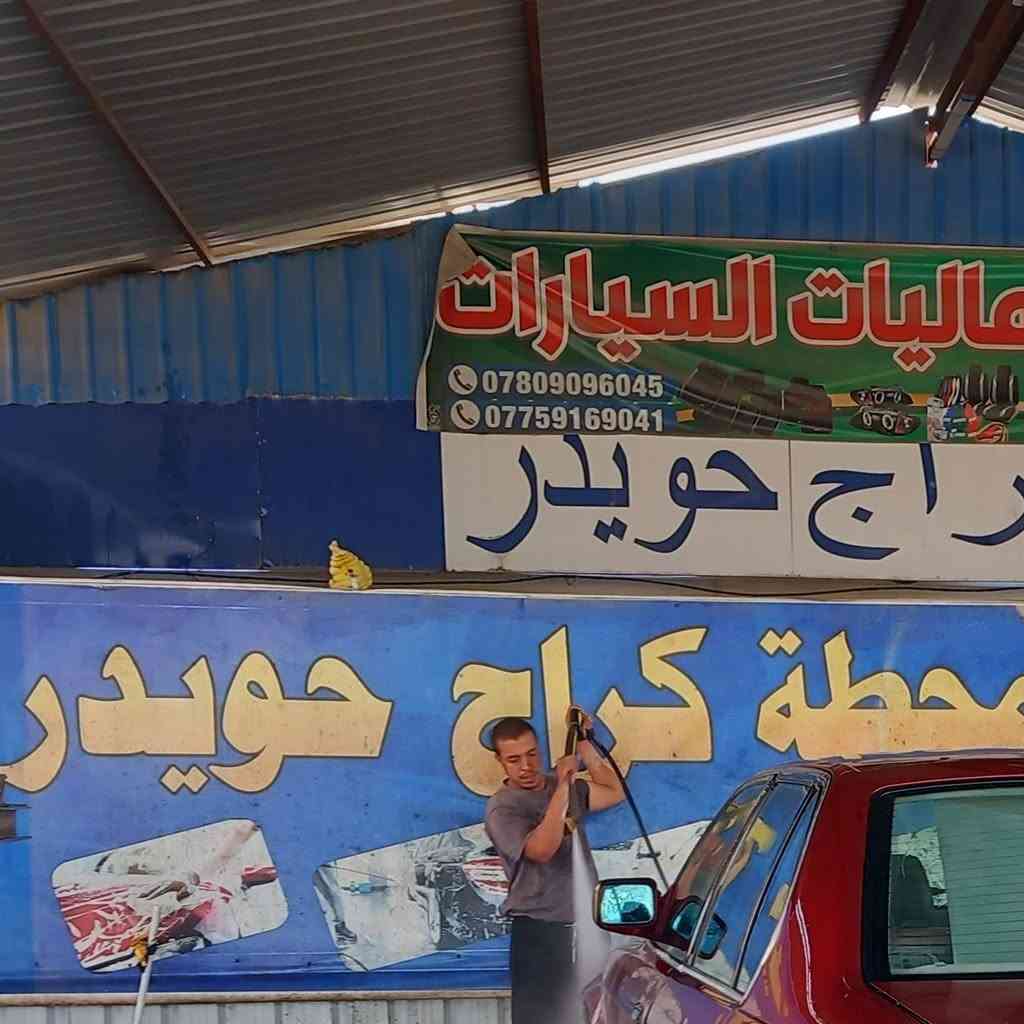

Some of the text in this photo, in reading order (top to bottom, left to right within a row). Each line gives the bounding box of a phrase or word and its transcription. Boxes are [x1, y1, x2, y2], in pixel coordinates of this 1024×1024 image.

[436, 247, 775, 361] السيارات
[482, 370, 664, 397] 07809096045
[485, 404, 664, 432] 07759169041
[466, 434, 779, 553] حويدر
[0, 645, 395, 794] حويدر
